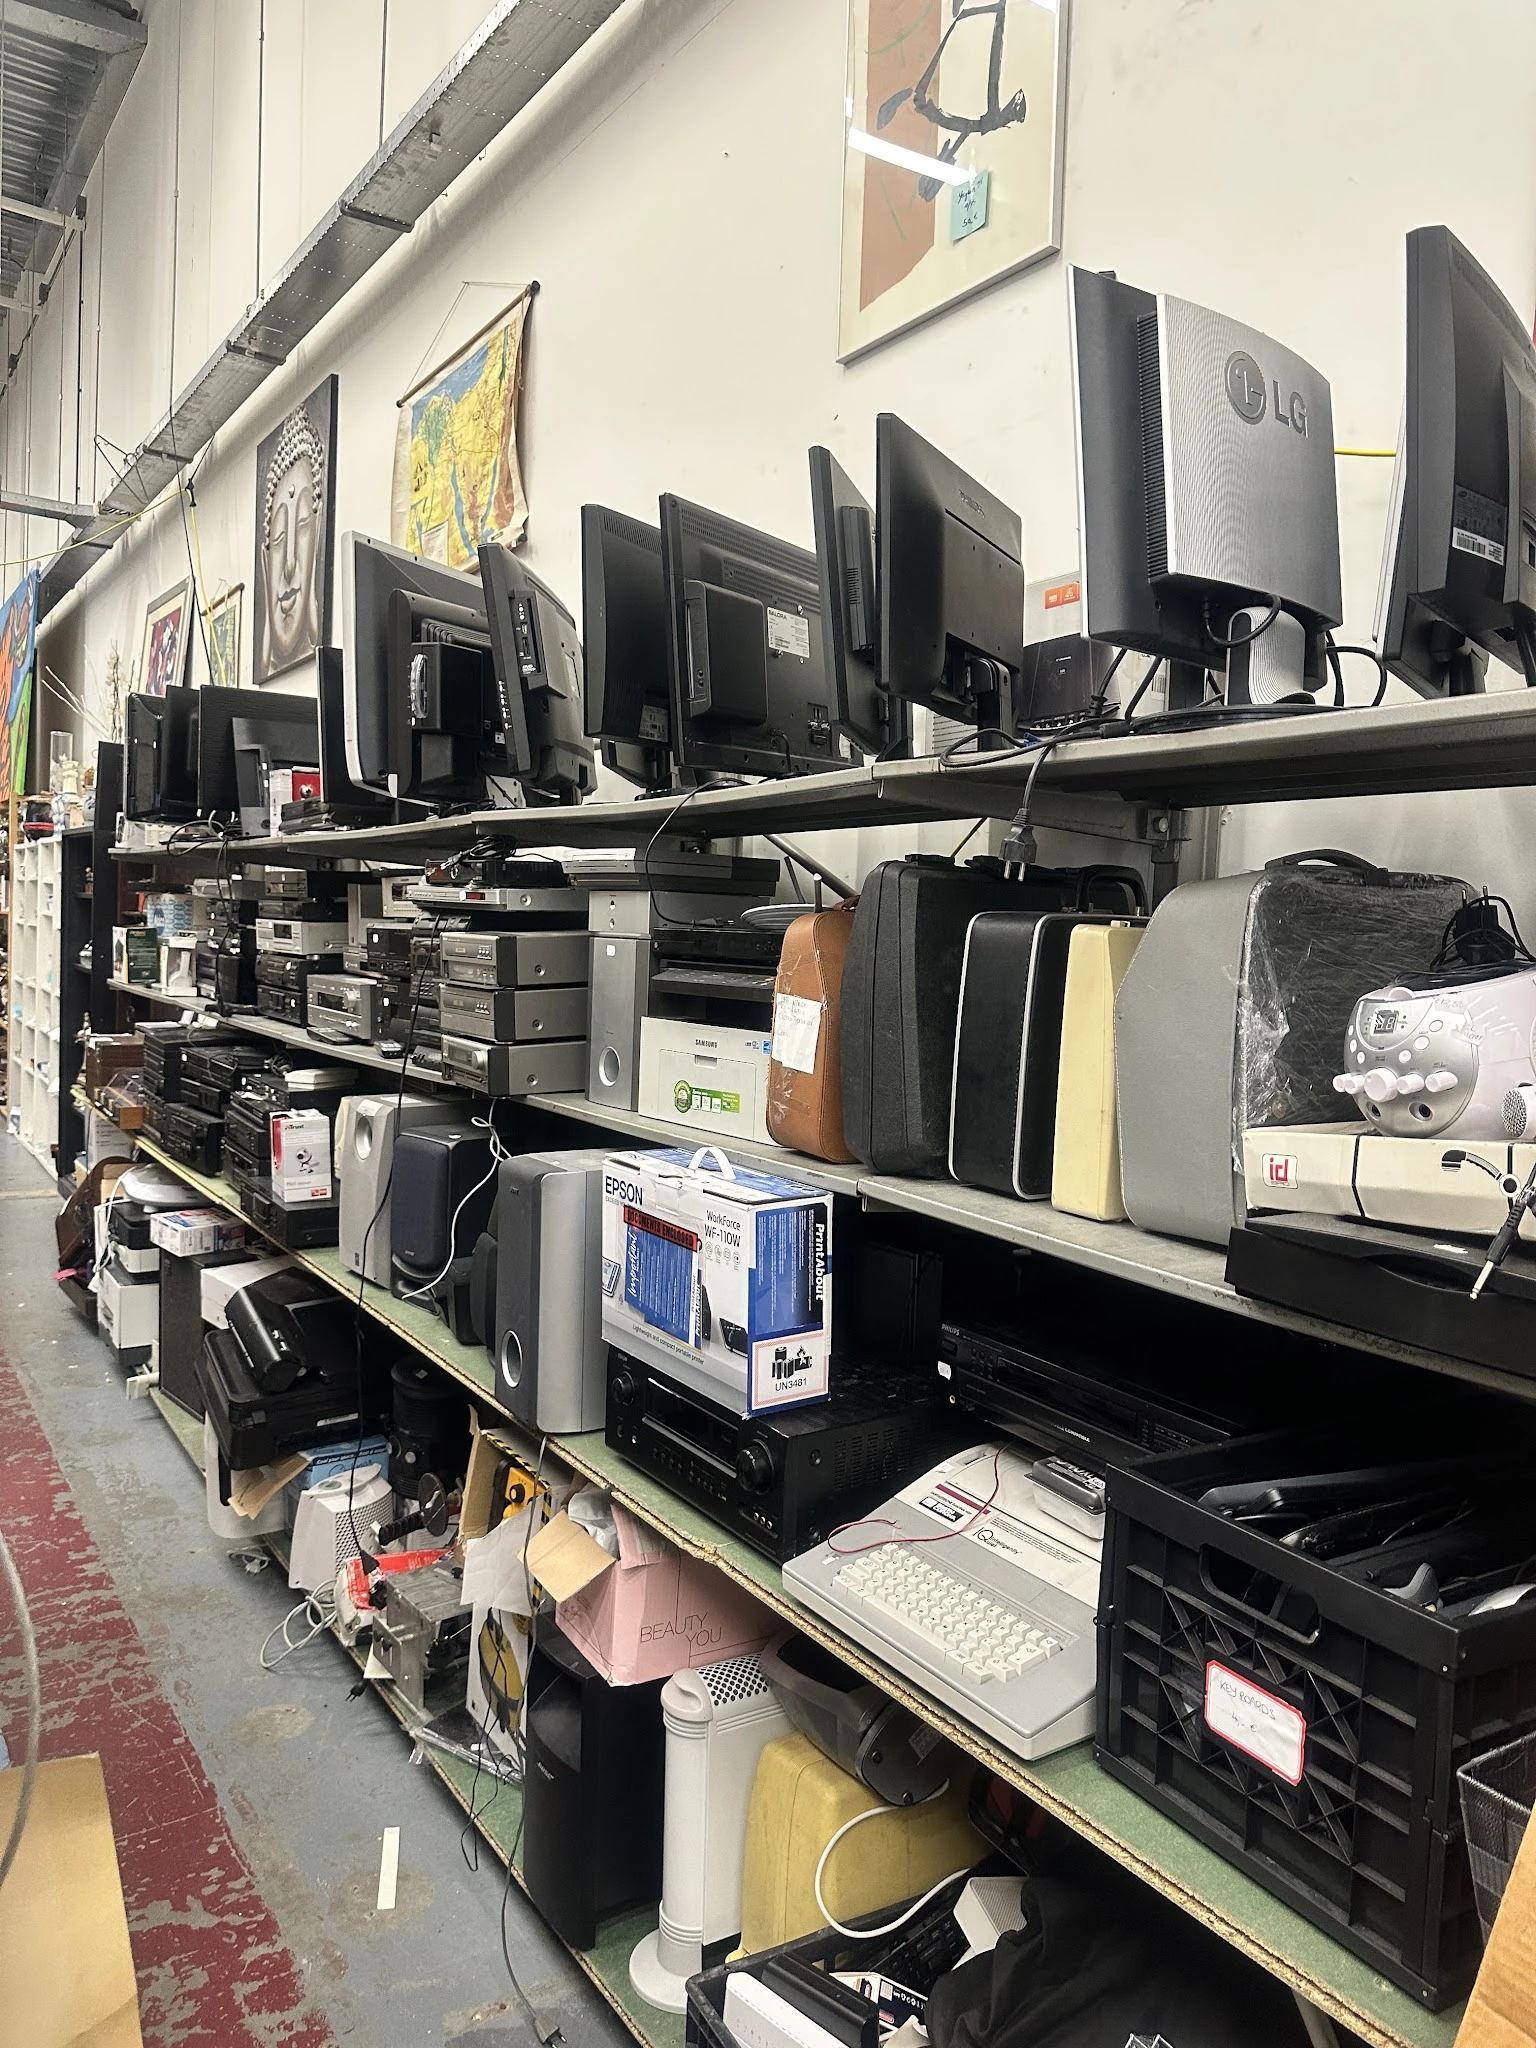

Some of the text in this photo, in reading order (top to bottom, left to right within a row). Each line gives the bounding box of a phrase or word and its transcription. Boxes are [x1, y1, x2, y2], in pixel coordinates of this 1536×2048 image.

[1272, 379, 1308, 438] LG
[695, 1039, 718, 1049] SAMSUNG
[605, 1174, 643, 1206] EPSON
[627, 1207, 695, 1247] DOCUMENTS ENCLOSED
[706, 1210, 740, 1231] WorkForce
[704, 1223, 741, 1248] WF-110W
[815, 1222, 826, 1301] PrintAbout
[941, 1323, 960, 1336] PHILIPS
[659, 1339, 676, 1350] compact
[675, 1346, 691, 1358] portable
[691, 1354, 704, 1365] printer
[775, 1377, 807, 1391] UN3481
[640, 1611, 708, 1644] BEAUTY
[685, 1626, 722, 1648] YOU
